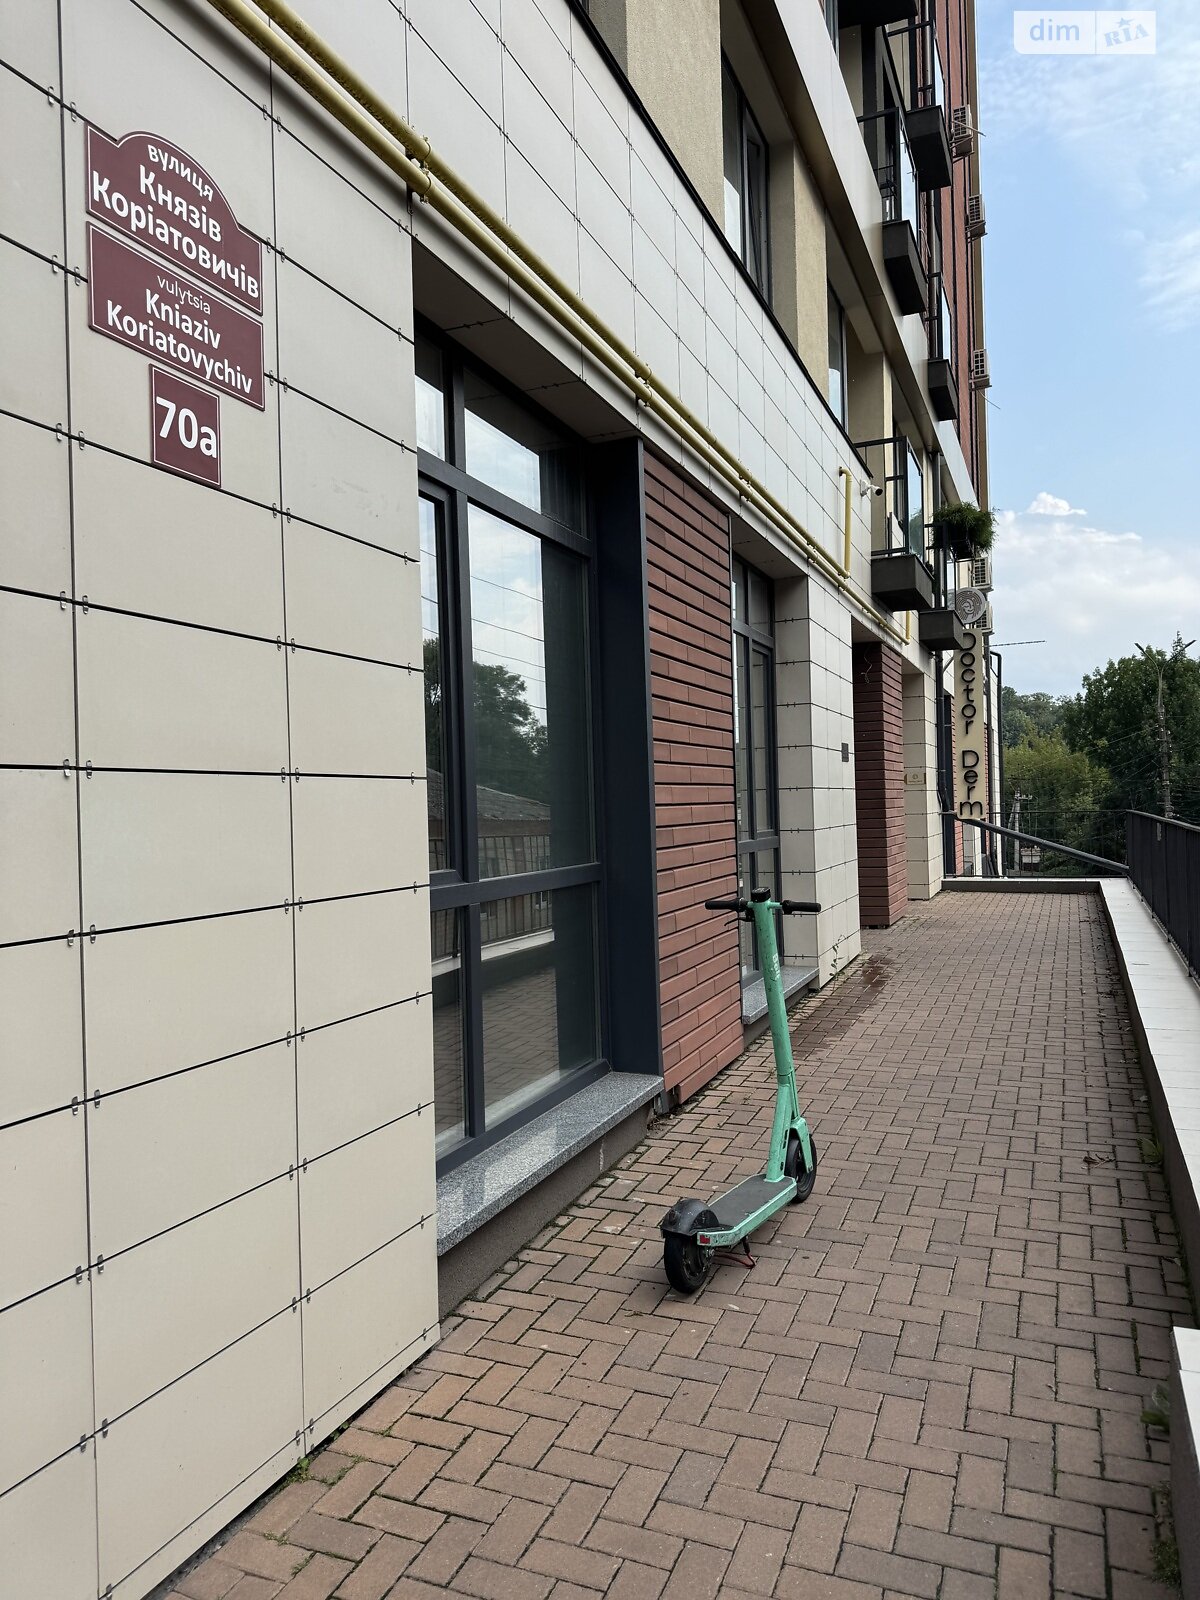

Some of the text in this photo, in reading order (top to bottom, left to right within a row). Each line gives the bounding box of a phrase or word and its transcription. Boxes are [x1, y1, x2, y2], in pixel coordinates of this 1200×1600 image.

[139, 164, 222, 242] Князів
[147, 144, 214, 202] вулиця
[92, 170, 260, 299] Коріатовичів
[145, 288, 221, 349] Kniaziv
[157, 275, 211, 315] vulytsia
[106, 299, 253, 394] Koriatovychiv
[959, 632, 983, 816] Doctor Derm
